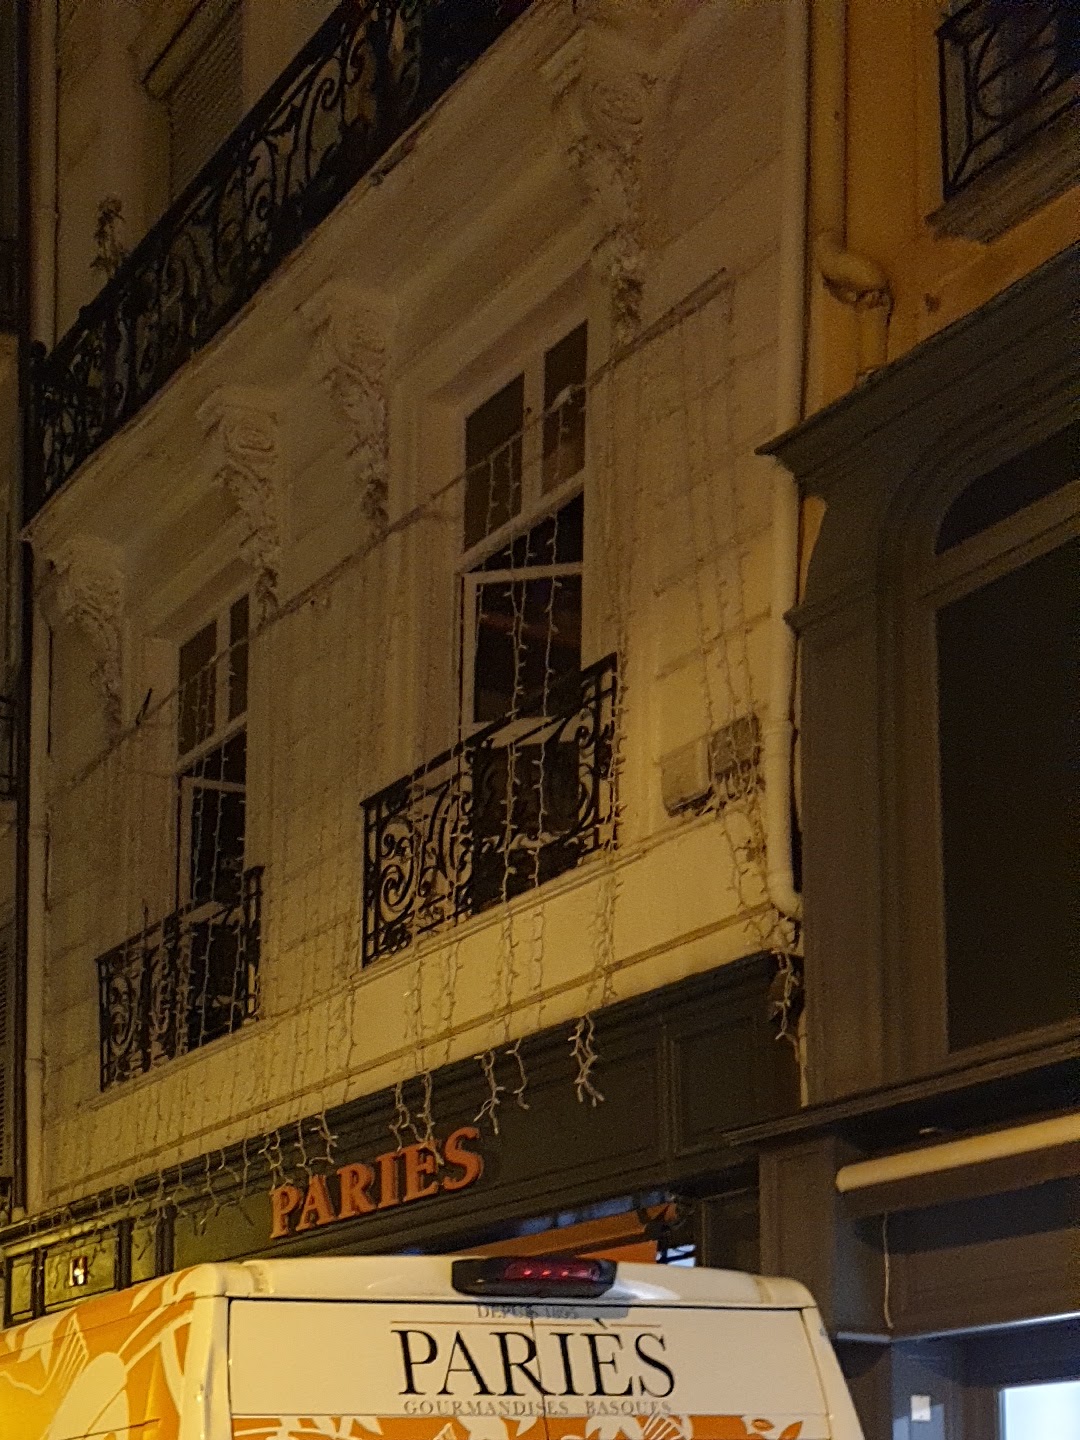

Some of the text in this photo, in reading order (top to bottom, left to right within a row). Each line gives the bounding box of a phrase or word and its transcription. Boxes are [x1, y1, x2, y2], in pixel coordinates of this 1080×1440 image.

[391, 1318, 675, 1397] PARIÈS
[404, 1400, 672, 1418] GOURMANDISES BASQUES
